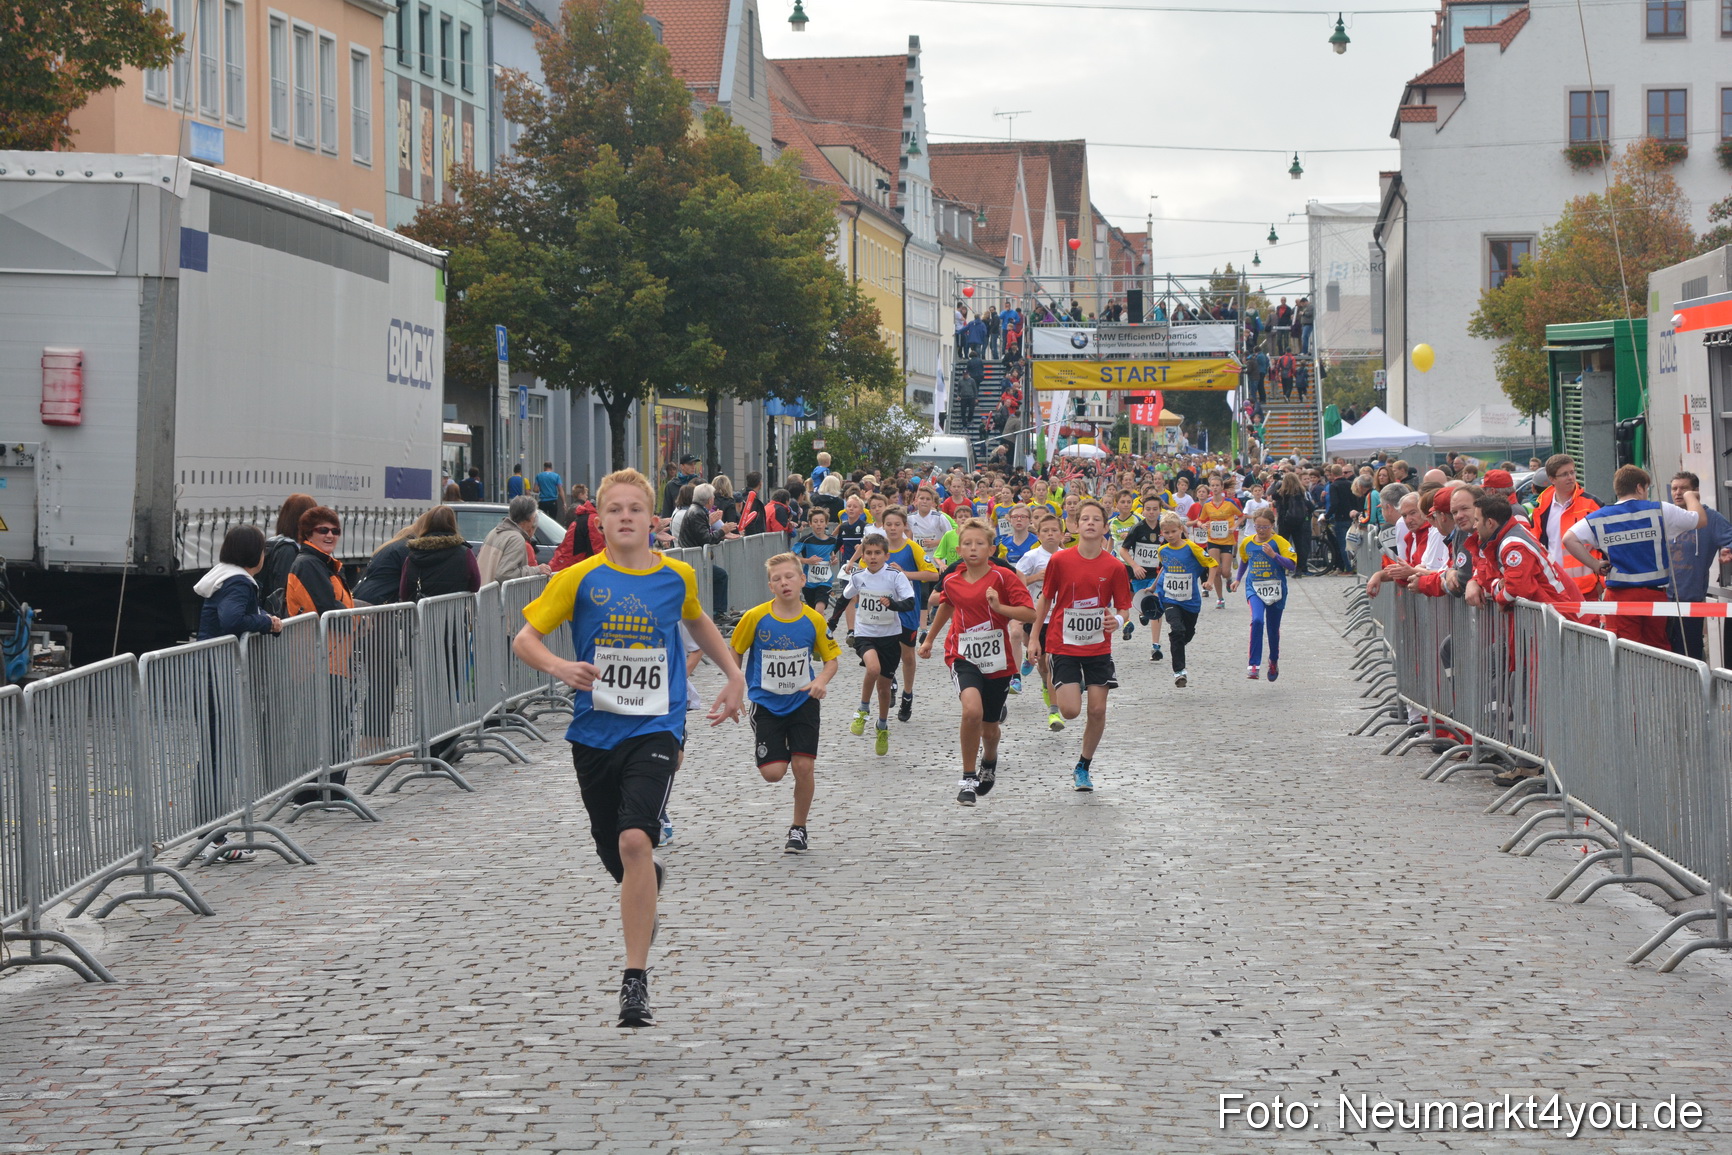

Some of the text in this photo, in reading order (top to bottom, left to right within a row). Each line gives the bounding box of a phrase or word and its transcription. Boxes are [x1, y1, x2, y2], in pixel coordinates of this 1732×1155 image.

[499, 330, 505, 356] P
[387, 318, 434, 390] BOCK
[1660, 330, 1678, 374] BOC
[1100, 366, 1171, 383] START
[1144, 396, 1154, 404] 20
[1121, 442, 1128, 450] A
[1211, 524, 1228, 532] 4015
[1603, 530, 1657, 544] SEG-LEITER
[1137, 549, 1158, 559] 4042
[810, 565, 829, 576] 4007
[1166, 580, 1189, 590] 4041
[1257, 586, 1280, 597] 4024
[1067, 616, 1102, 632] 4000
[963, 639, 1000, 659] 4028
[597, 653, 621, 661] PARTL
[766, 659, 805, 678] 4047
[601, 664, 661, 690] 4046
[617, 695, 644, 706] David
